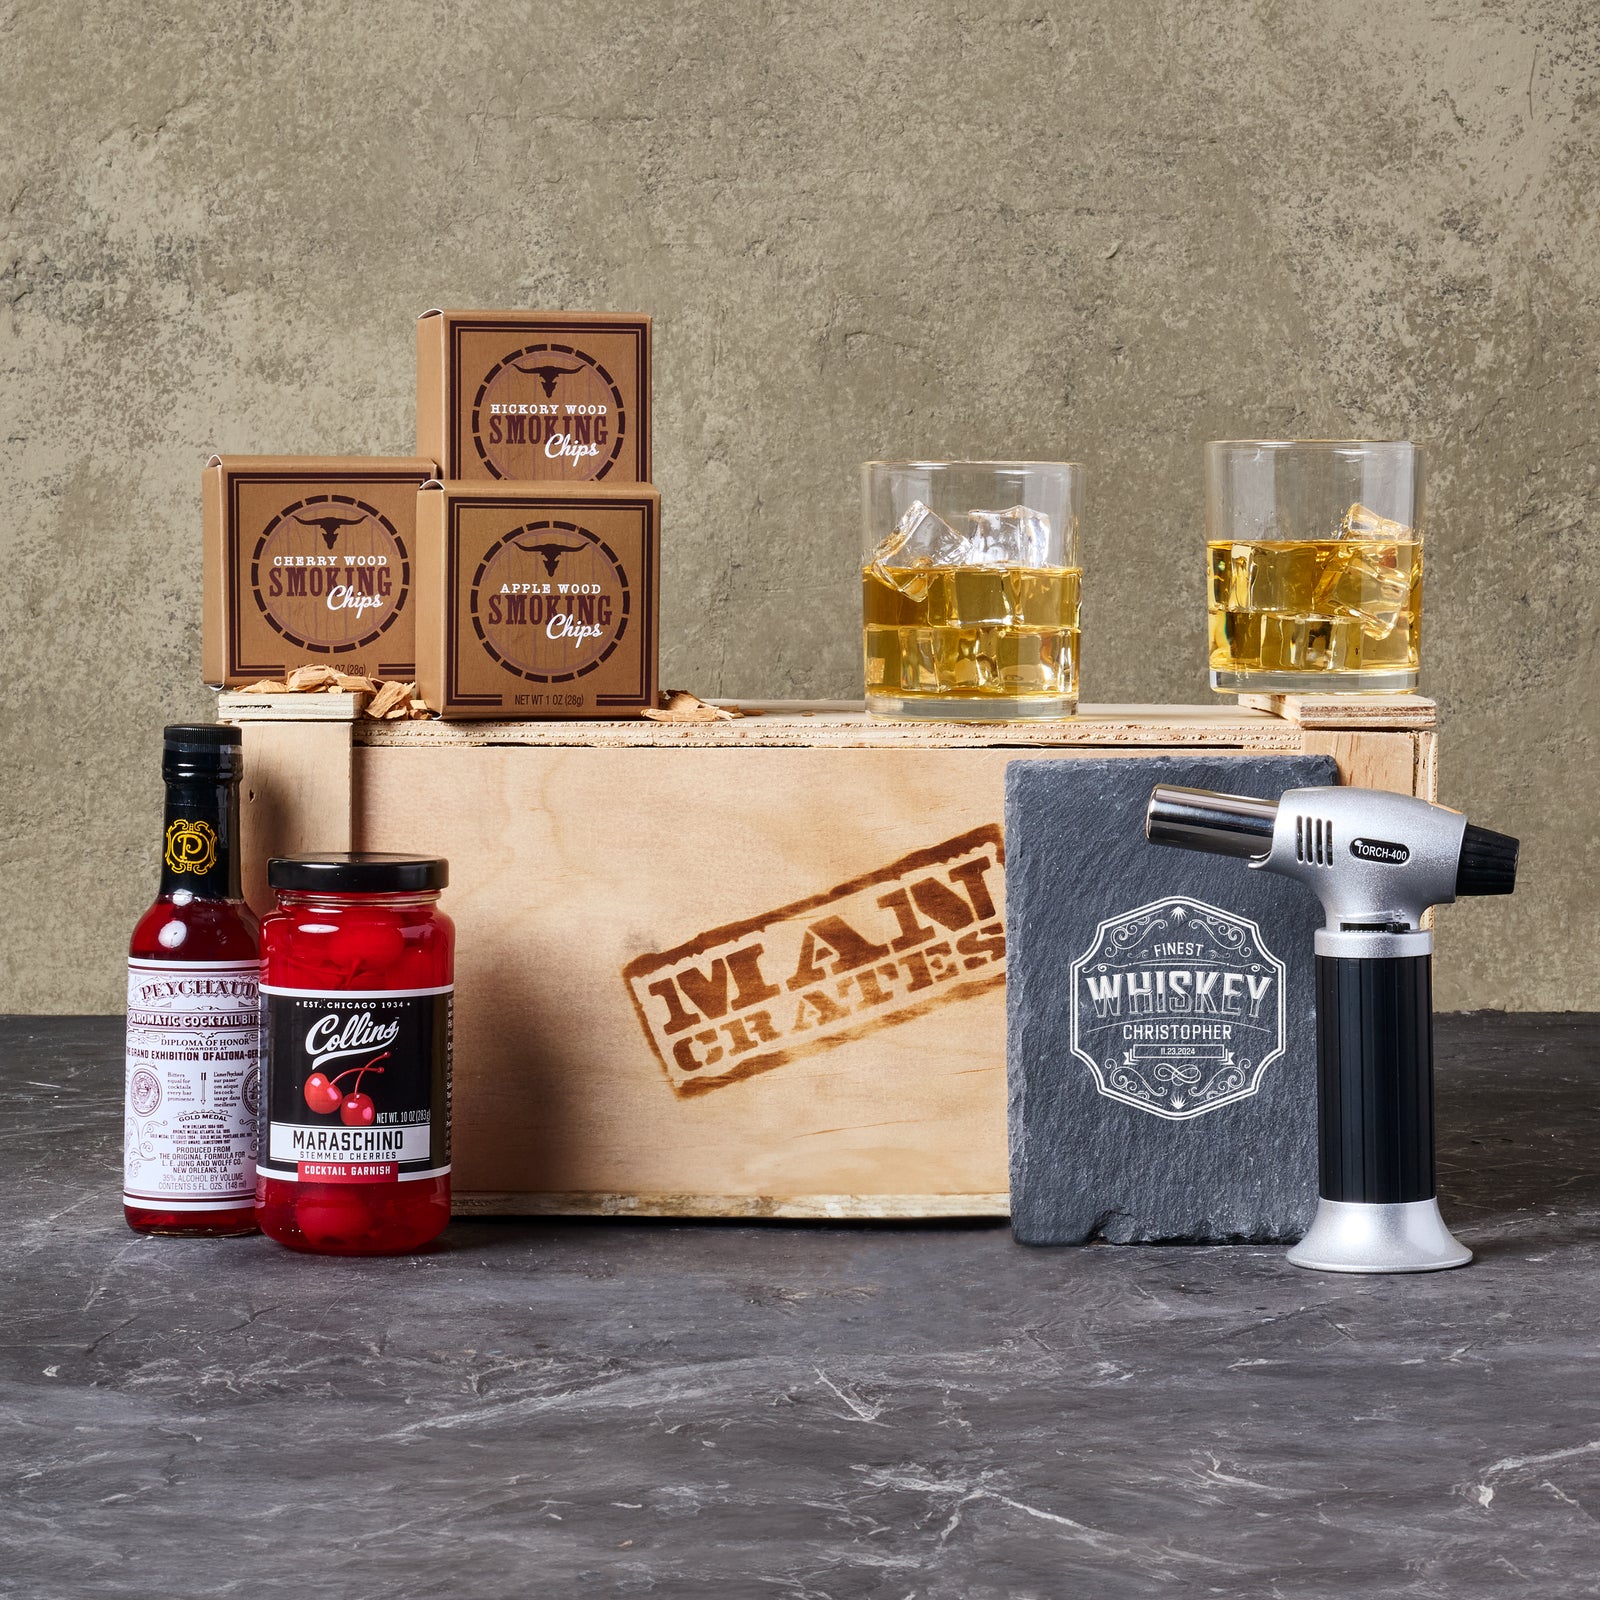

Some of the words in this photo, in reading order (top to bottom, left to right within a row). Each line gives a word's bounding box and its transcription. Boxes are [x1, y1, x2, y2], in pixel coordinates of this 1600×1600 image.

[490, 404, 560, 415] HICKORY
[565, 404, 607, 415] WOOD
[489, 414, 608, 445] SMOKING
[544, 433, 600, 467] Chips
[274, 556, 338, 566] CHERRY
[344, 556, 388, 566] WOOD
[268, 566, 392, 597] SMOKING
[500, 584, 550, 594] APPLE
[558, 584, 600, 594] WOOD
[327, 585, 384, 619] Chips
[488, 595, 612, 625] SMOKING
[546, 614, 603, 648] Chips
[347, 664, 366, 676] (28g)
[514, 695, 530, 705] NET
[531, 695, 544, 705] WT
[546, 695, 550, 705] 1
[552, 695, 563, 705] OZ
[565, 695, 584, 706] (28g)
[177, 833, 202, 861] P
[1355, 843, 1406, 860] TORCH-400
[648, 855, 997, 1036] MAN
[1154, 942, 1204, 957] FINEST
[672, 922, 1006, 1072] CRATES
[1086, 970, 1273, 1018] WHISKEY
[132, 1014, 180, 1026] AROMATIC
[183, 1015, 240, 1027] COCKTAIL
[305, 1011, 400, 1056] Collins
[1123, 1024, 1232, 1040] CHRISTOPHER
[152, 1050, 199, 1060] EXHIBITION
[1160, 1048, 1196, 1056] 11.23.2024
[179, 1114, 200, 1122] GOLD
[376, 1112, 388, 1124] NET
[389, 1112, 399, 1123] WT.
[401, 1111, 408, 1122] 10
[408, 1110, 415, 1122] OZ
[293, 1130, 403, 1150] MARASCHINO
[300, 1151, 344, 1160] STEMMED
[350, 1151, 396, 1160] CHERRIES
[220, 1173, 243, 1181] VOLUME
[305, 1165, 346, 1176] COCKTAIL
[351, 1165, 390, 1175] GARNISH
[158, 1182, 191, 1190] CONTENTS
